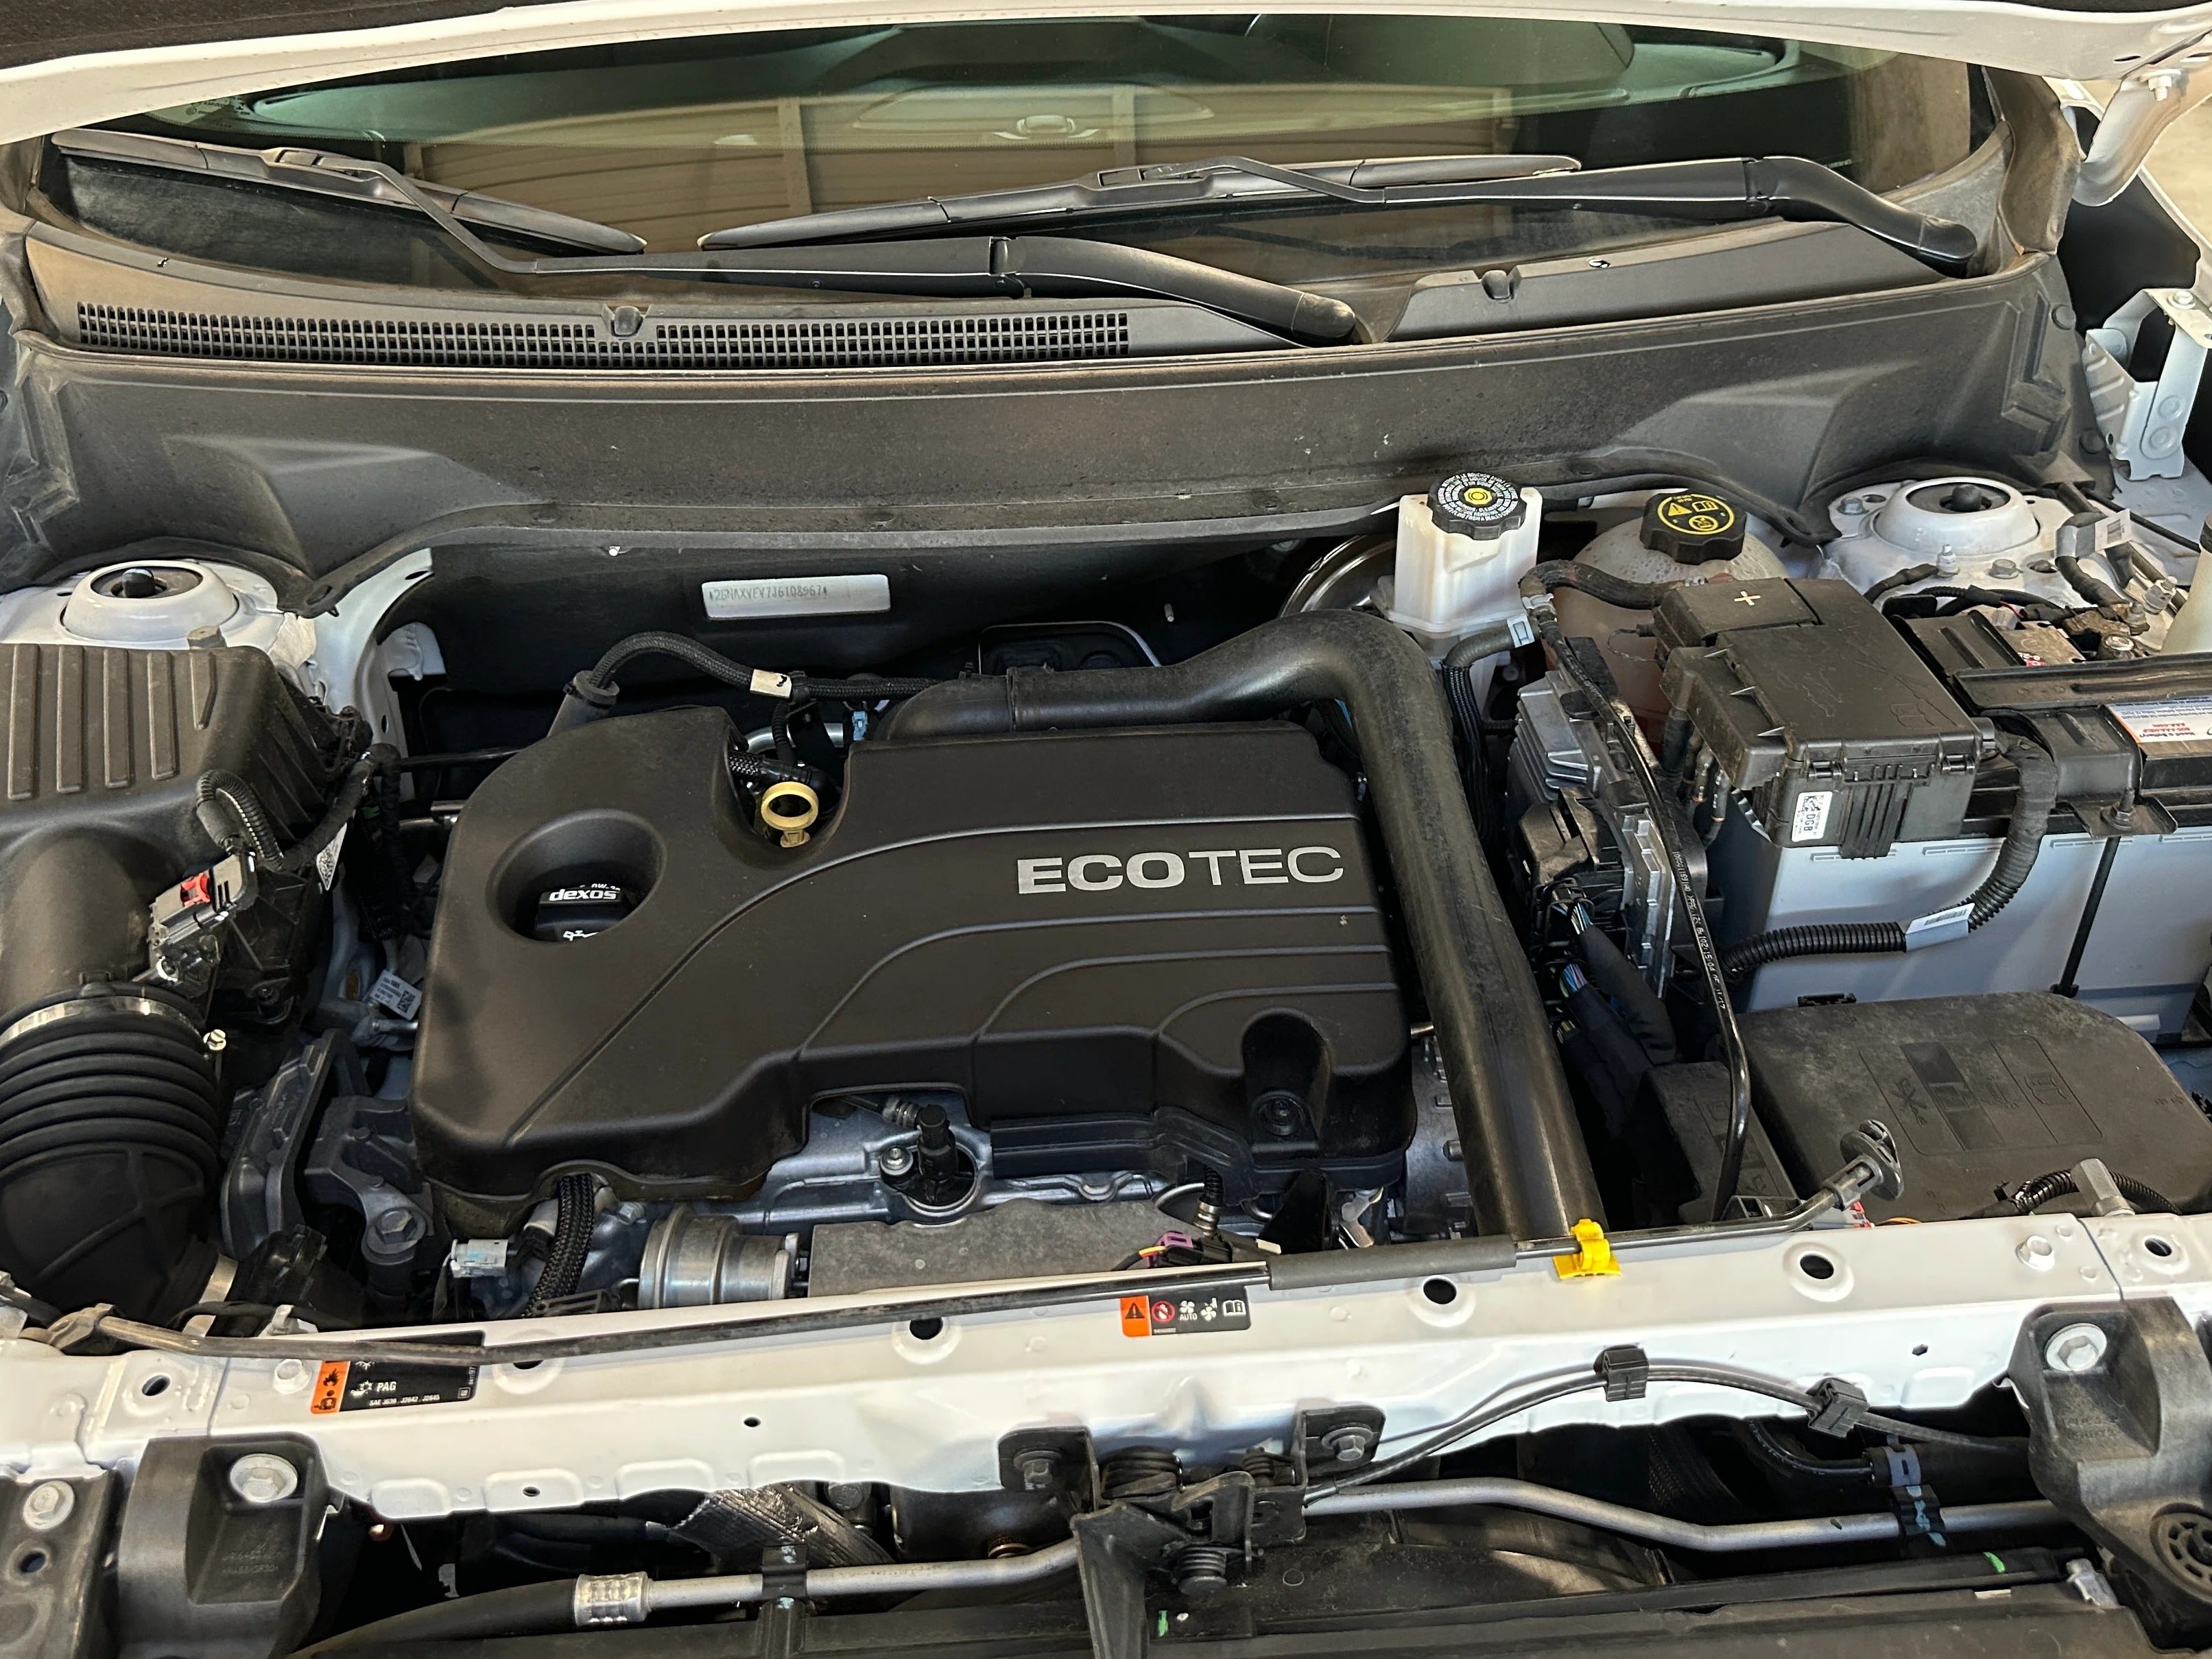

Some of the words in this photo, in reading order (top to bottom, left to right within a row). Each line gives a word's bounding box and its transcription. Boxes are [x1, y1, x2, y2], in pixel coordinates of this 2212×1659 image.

[1804, 814, 1816, 831] DGB
[1017, 846, 1344, 894] ECOTEC
[549, 889, 617, 901] dexos
[1179, 1313, 1198, 1321] AUTO
[377, 1381, 397, 1392] PAG
